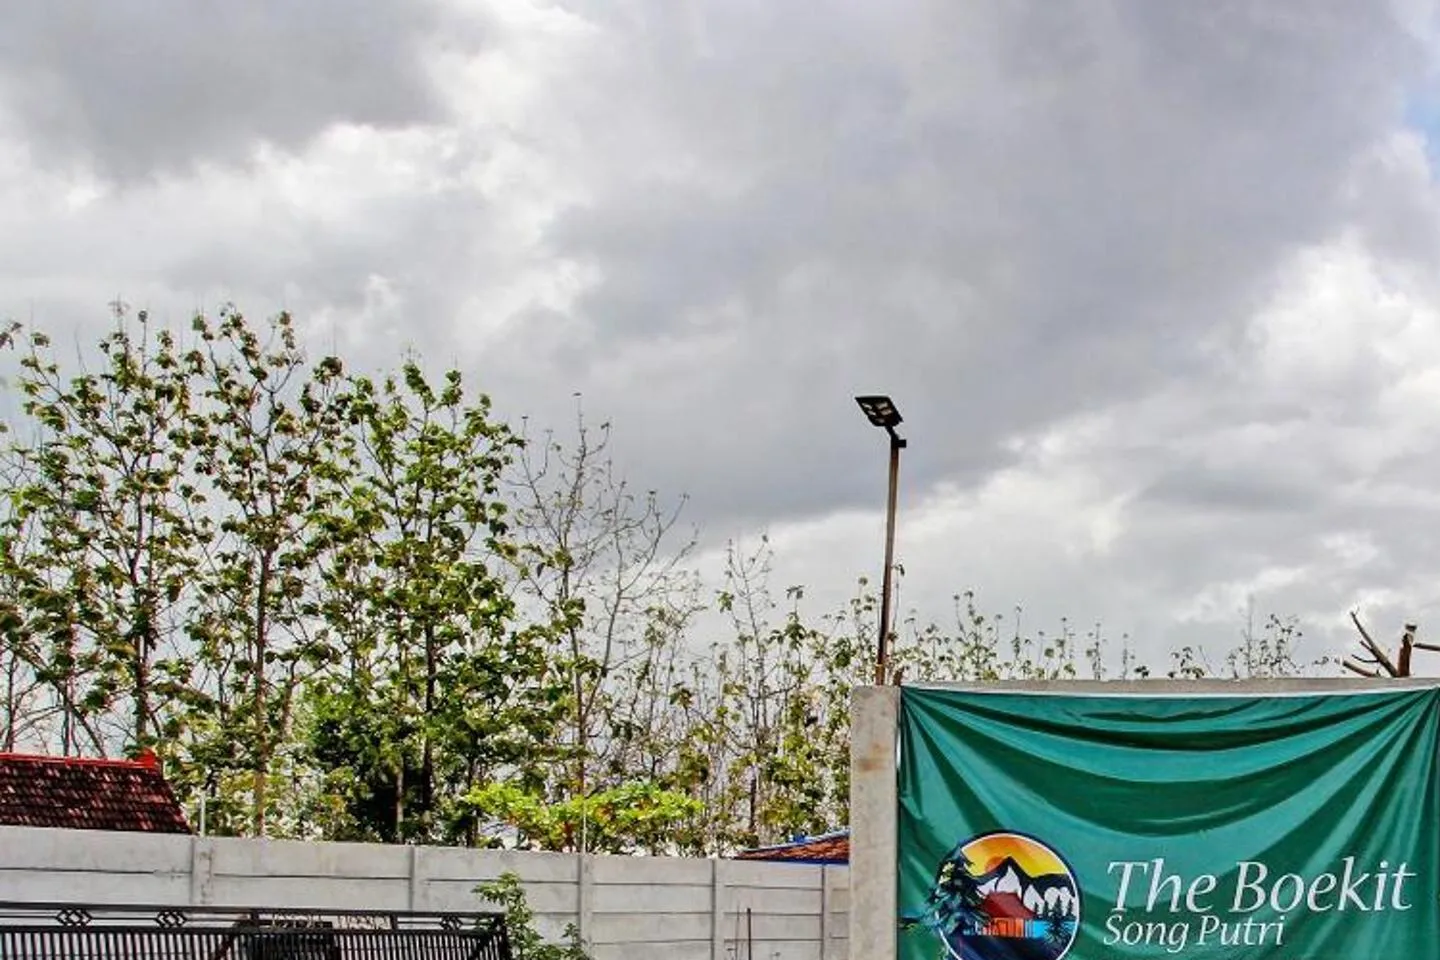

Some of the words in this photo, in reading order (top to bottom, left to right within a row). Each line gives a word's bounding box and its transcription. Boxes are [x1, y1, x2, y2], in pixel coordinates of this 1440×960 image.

[1106, 857, 1217, 913] The
[1228, 855, 1417, 913] Boekit
[1102, 914, 1190, 953] Song
[1197, 914, 1286, 946] Putri
